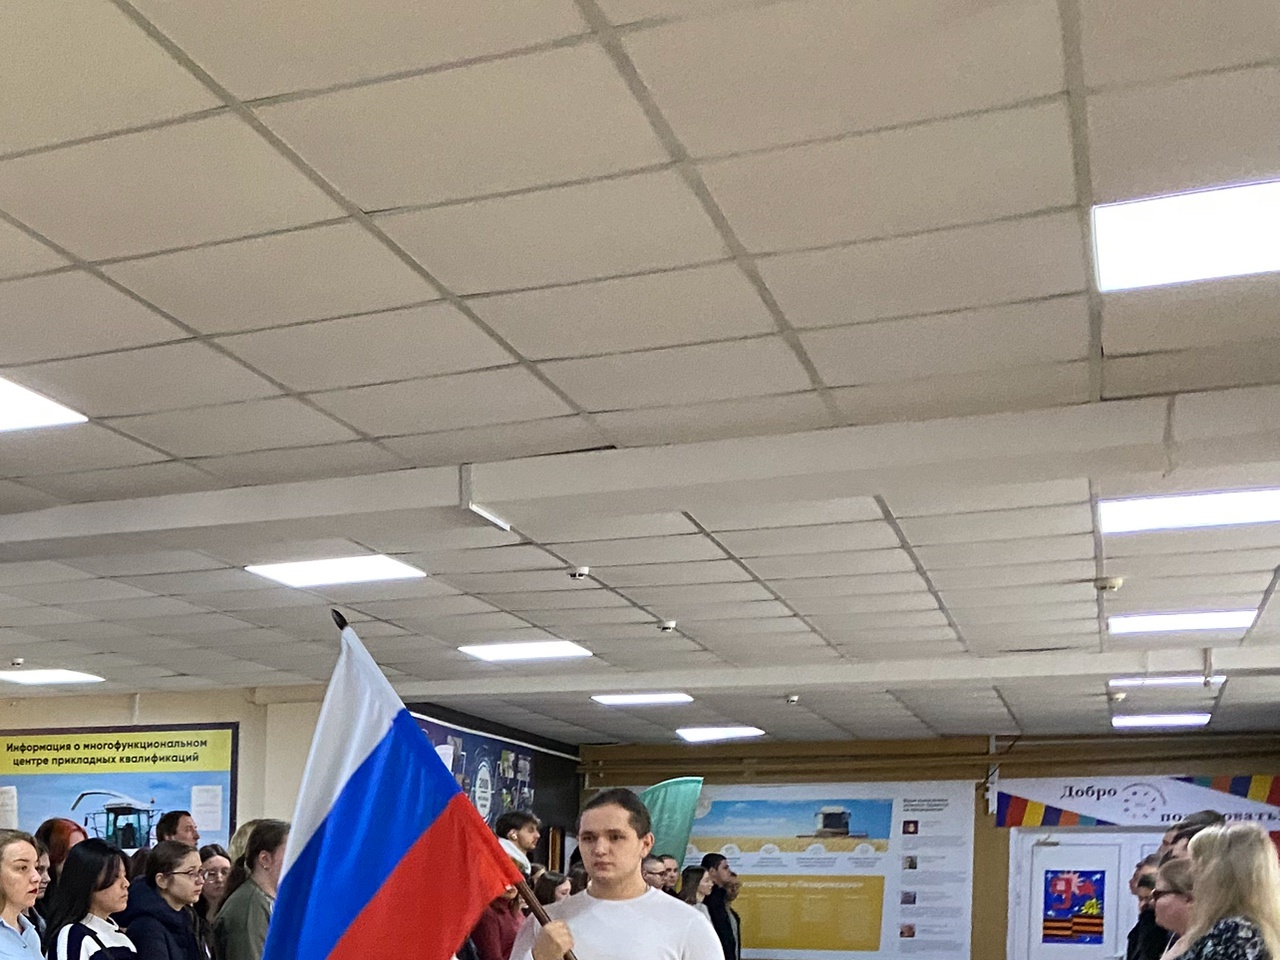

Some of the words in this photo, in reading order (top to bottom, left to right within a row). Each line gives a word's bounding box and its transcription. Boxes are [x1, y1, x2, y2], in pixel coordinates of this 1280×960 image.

[6, 742, 72, 754] Информация
[73, 743, 81, 751] о
[83, 740, 208, 752] многофункциональном
[13, 757, 50, 768] центре
[51, 755, 117, 767] прикладных
[119, 752, 200, 765] квалификаций
[1060, 785, 1118, 801] Добро
[1161, 811, 1280, 822] поовать
